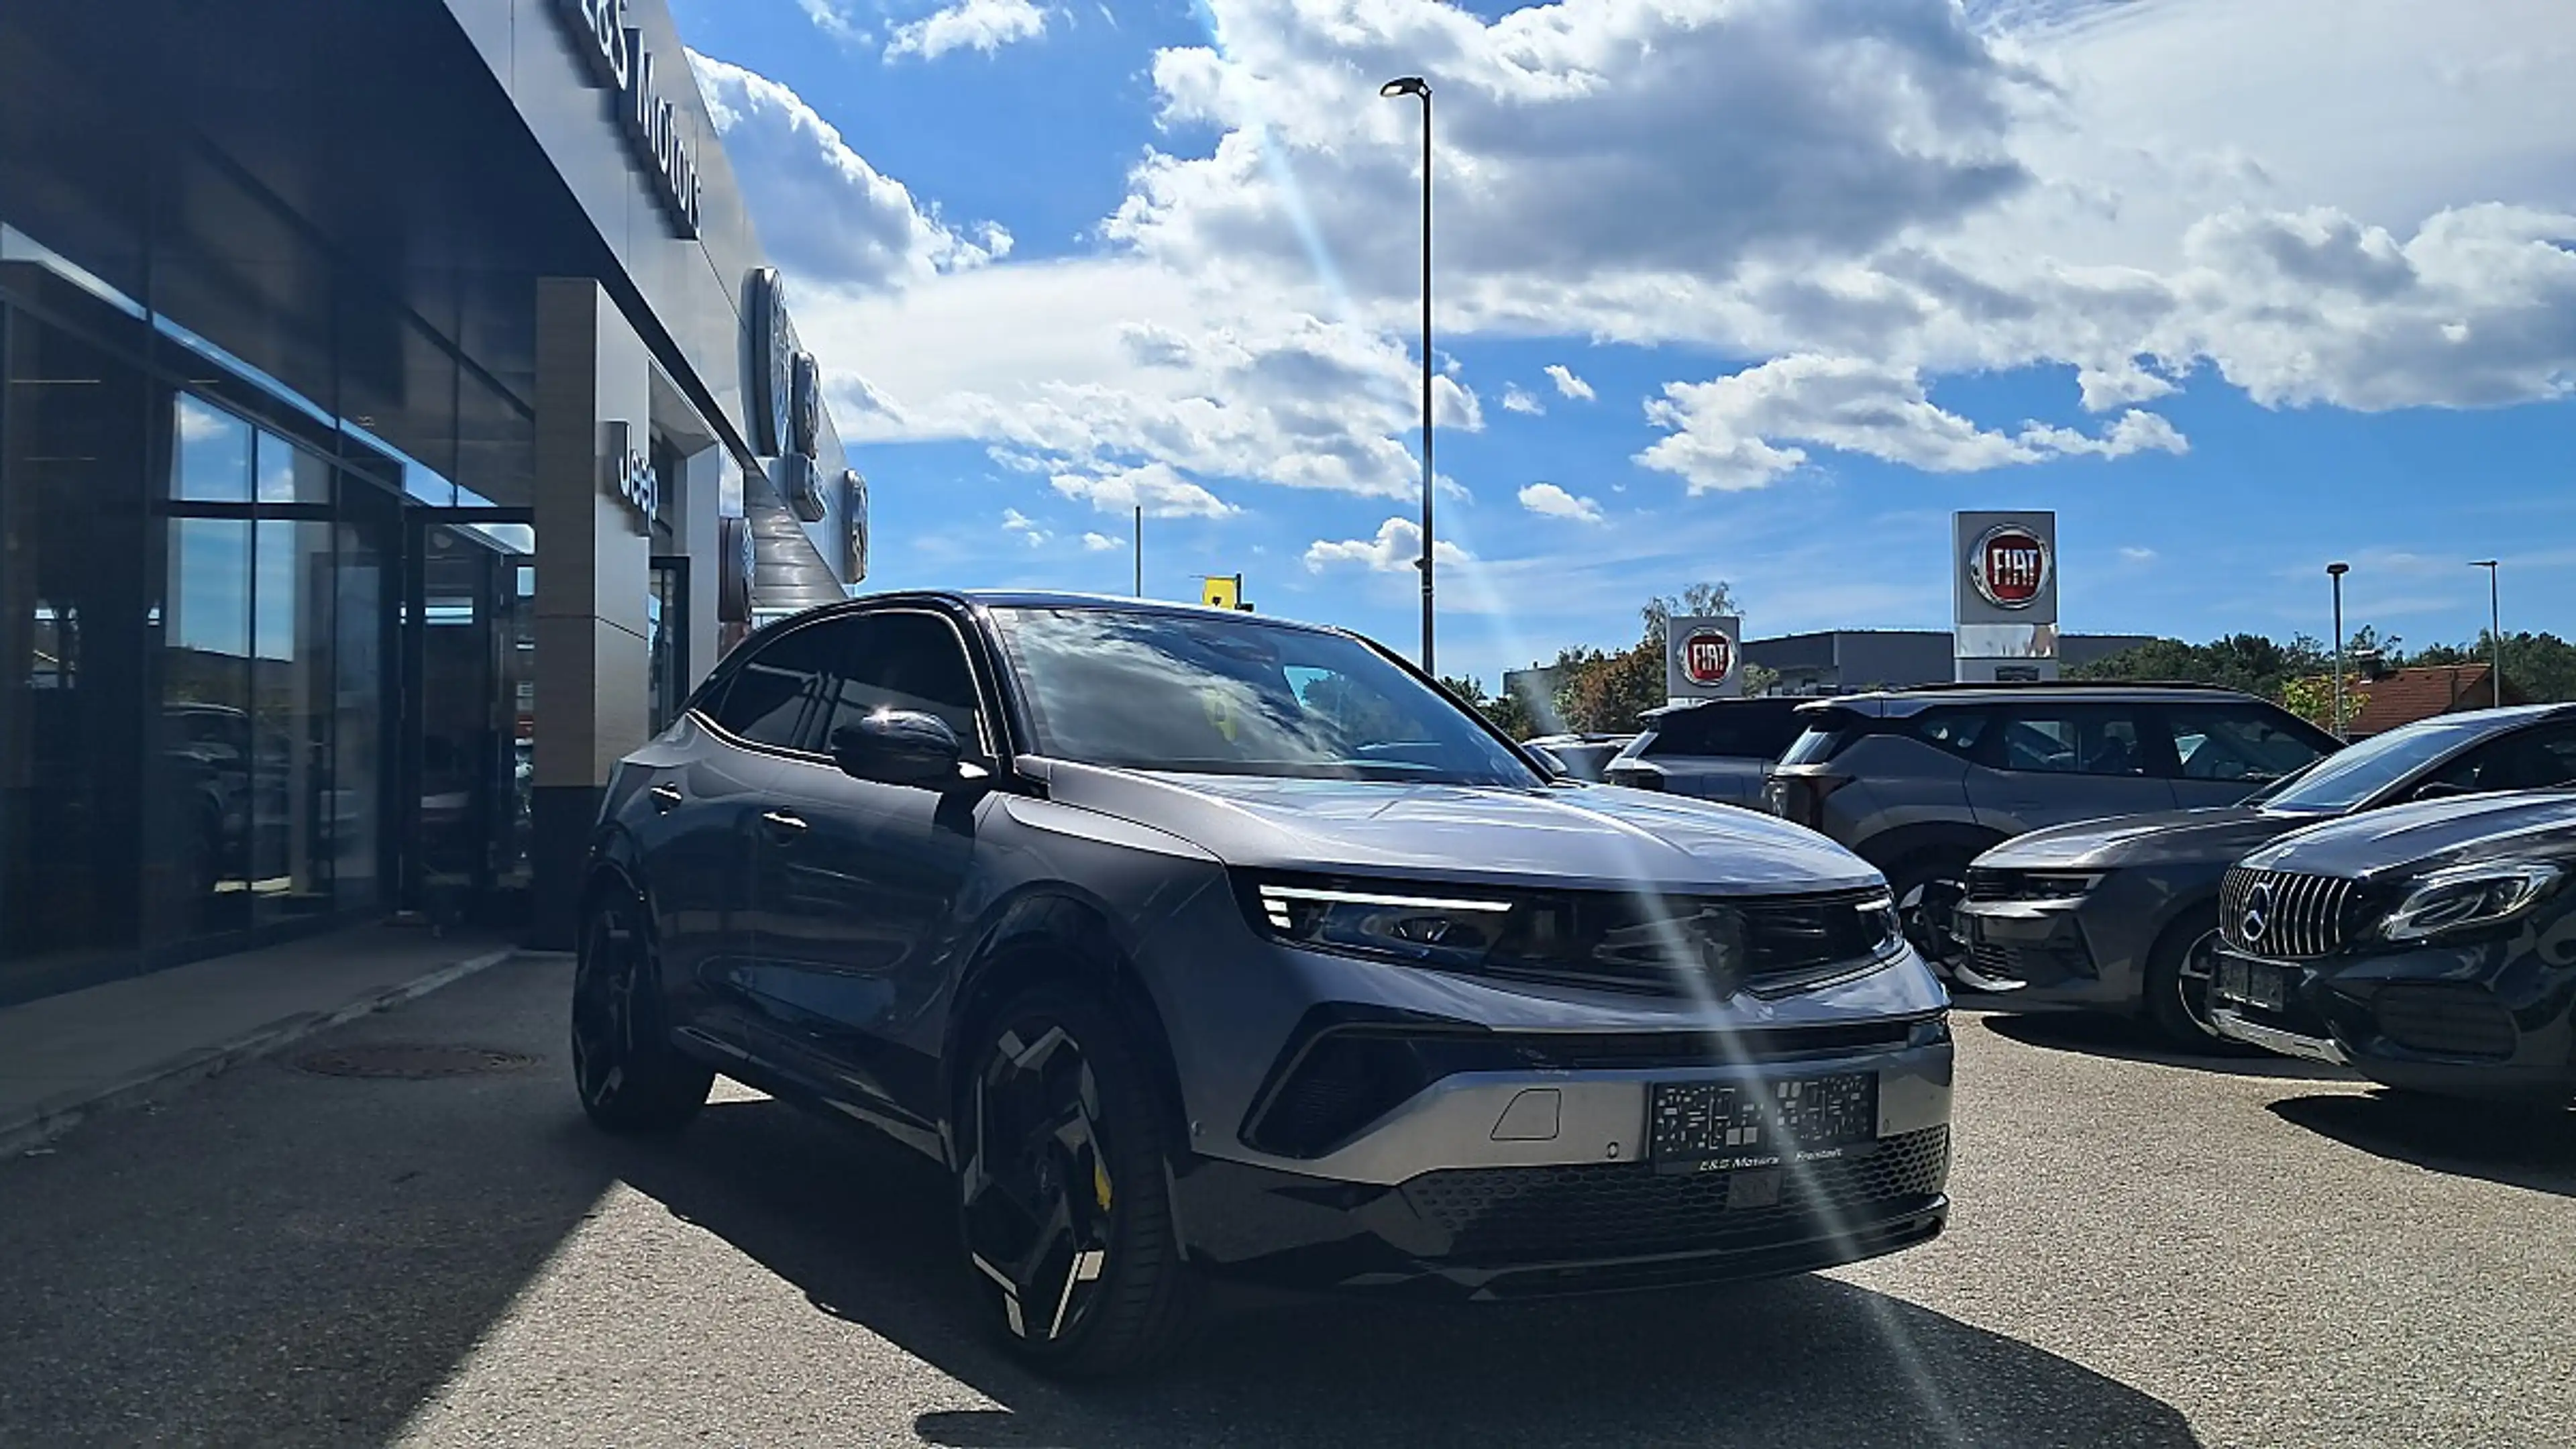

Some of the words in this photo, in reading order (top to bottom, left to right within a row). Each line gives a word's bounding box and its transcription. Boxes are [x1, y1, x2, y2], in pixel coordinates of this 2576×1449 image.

[618, 424, 658, 533] Jeep
[1992, 548, 2039, 587] FIAT
[1693, 643, 1725, 671] FIAT
